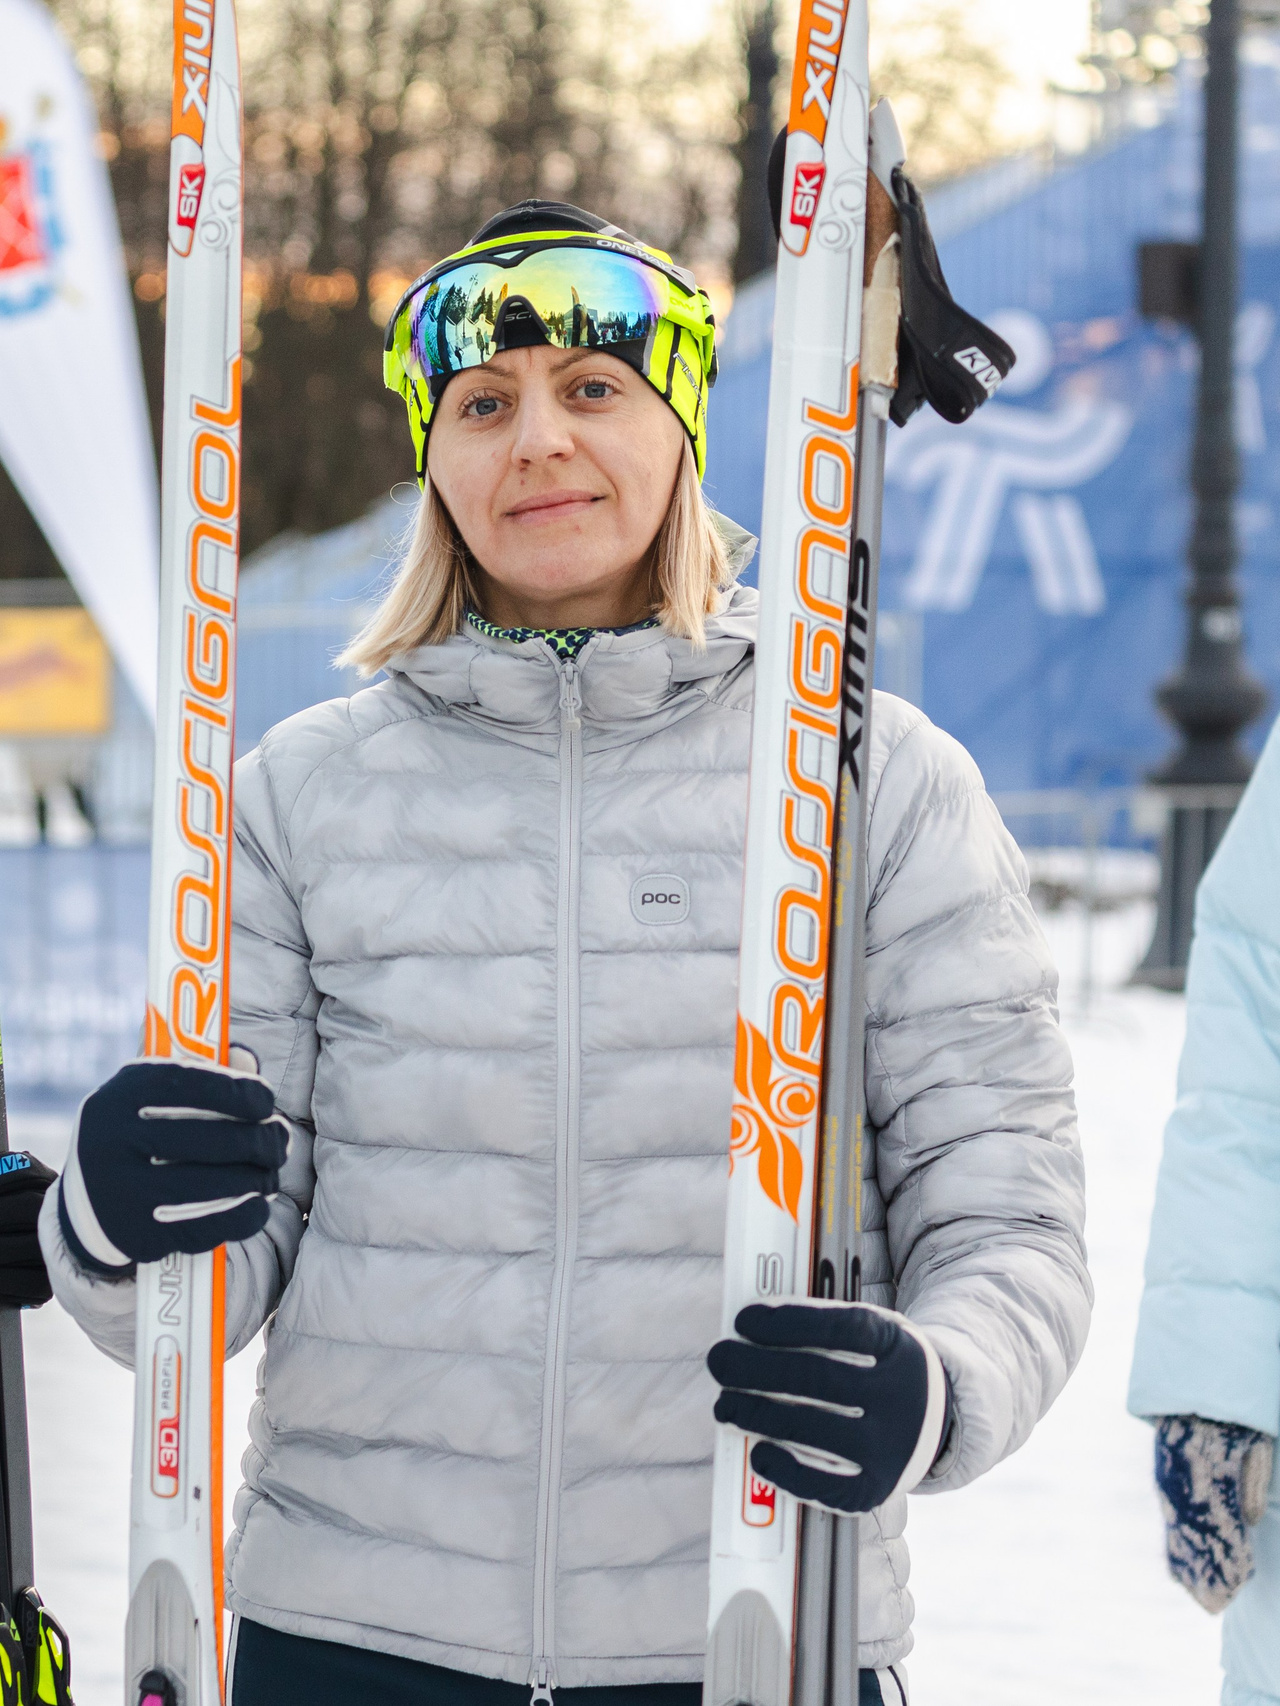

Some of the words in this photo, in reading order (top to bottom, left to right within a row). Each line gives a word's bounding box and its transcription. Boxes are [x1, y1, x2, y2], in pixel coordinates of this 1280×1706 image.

[180, 174, 201, 218] SK
[793, 173, 820, 216] SK
[596, 239, 670, 271] ONEWAY
[169, 355, 241, 1062] ROSSIGNOL
[771, 360, 859, 1076] ROSSIGNOL
[160, 1356, 173, 1411] PROFIL
[160, 1429, 178, 1468] 3D
